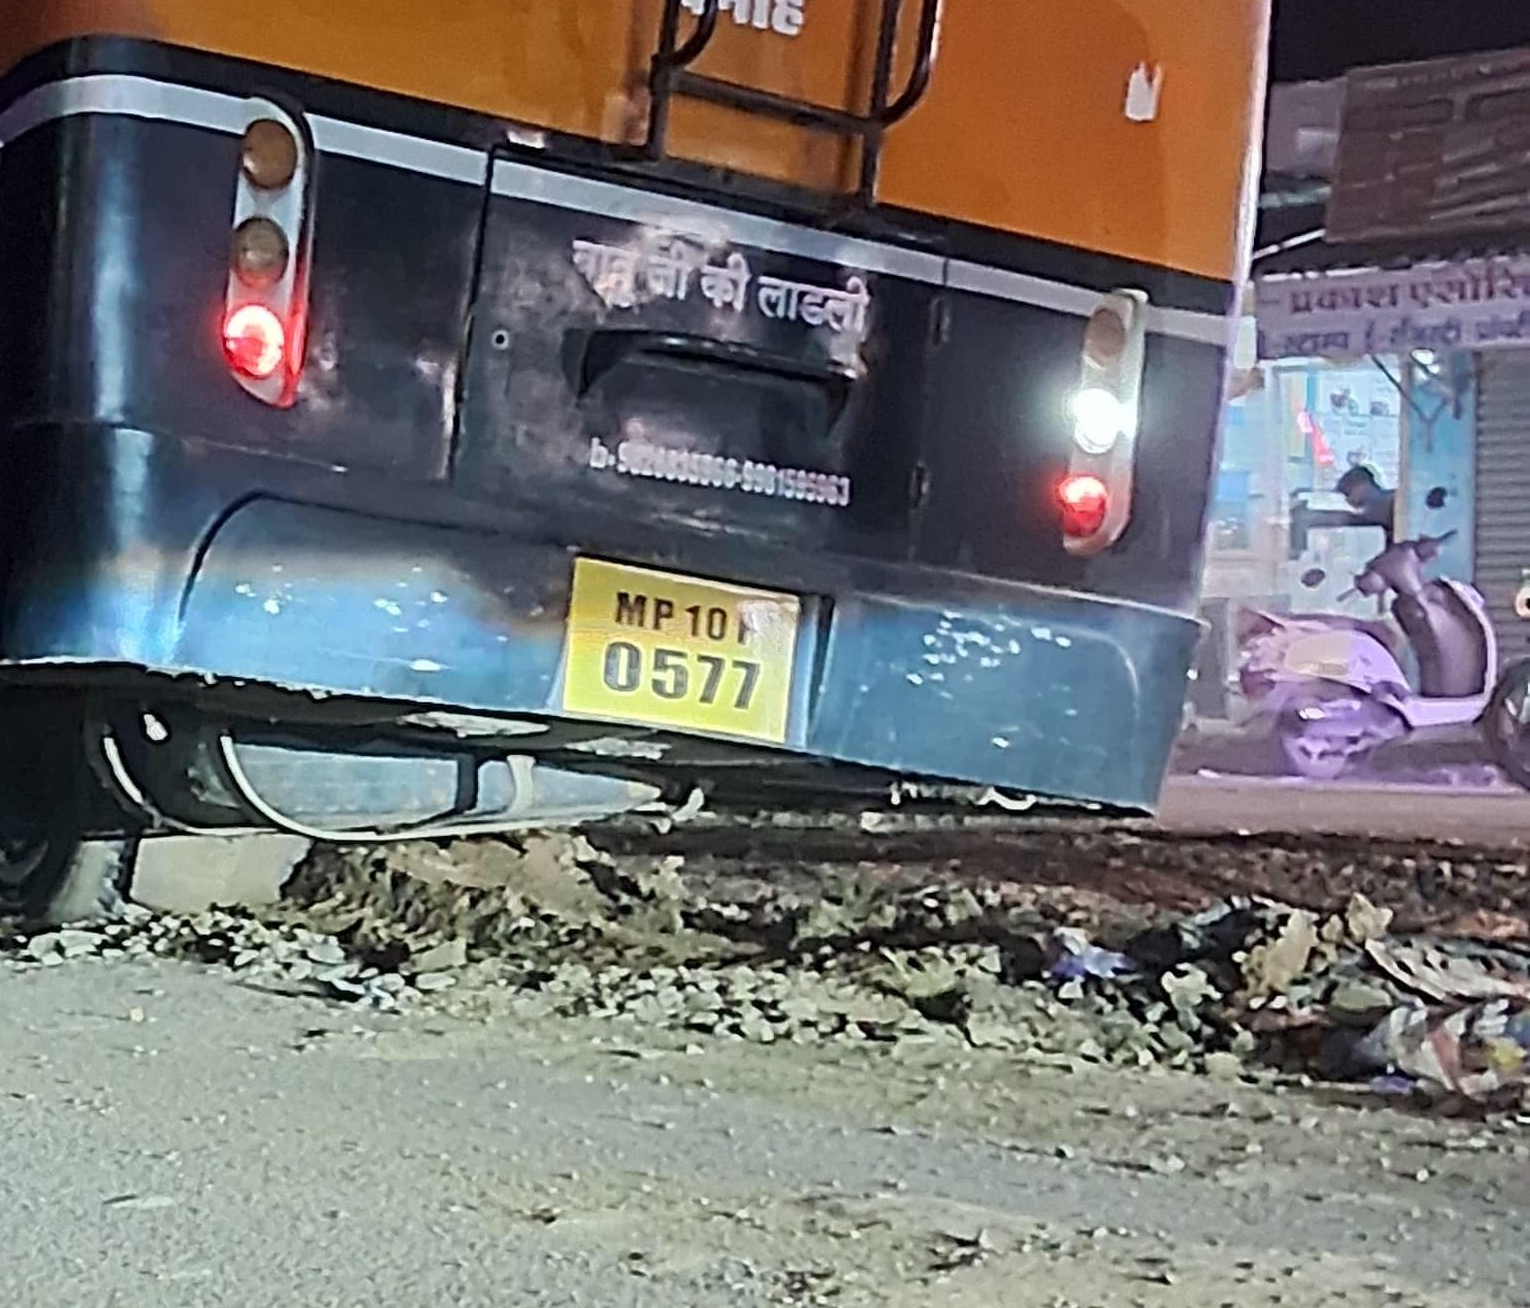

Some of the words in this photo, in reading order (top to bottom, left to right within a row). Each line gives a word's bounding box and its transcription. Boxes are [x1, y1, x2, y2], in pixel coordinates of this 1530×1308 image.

[700, 252, 752, 312] की
[757, 275, 872, 342] लाडली
[1289, 283, 1398, 314] प्रकाश
[602, 640, 762, 711] 0577
